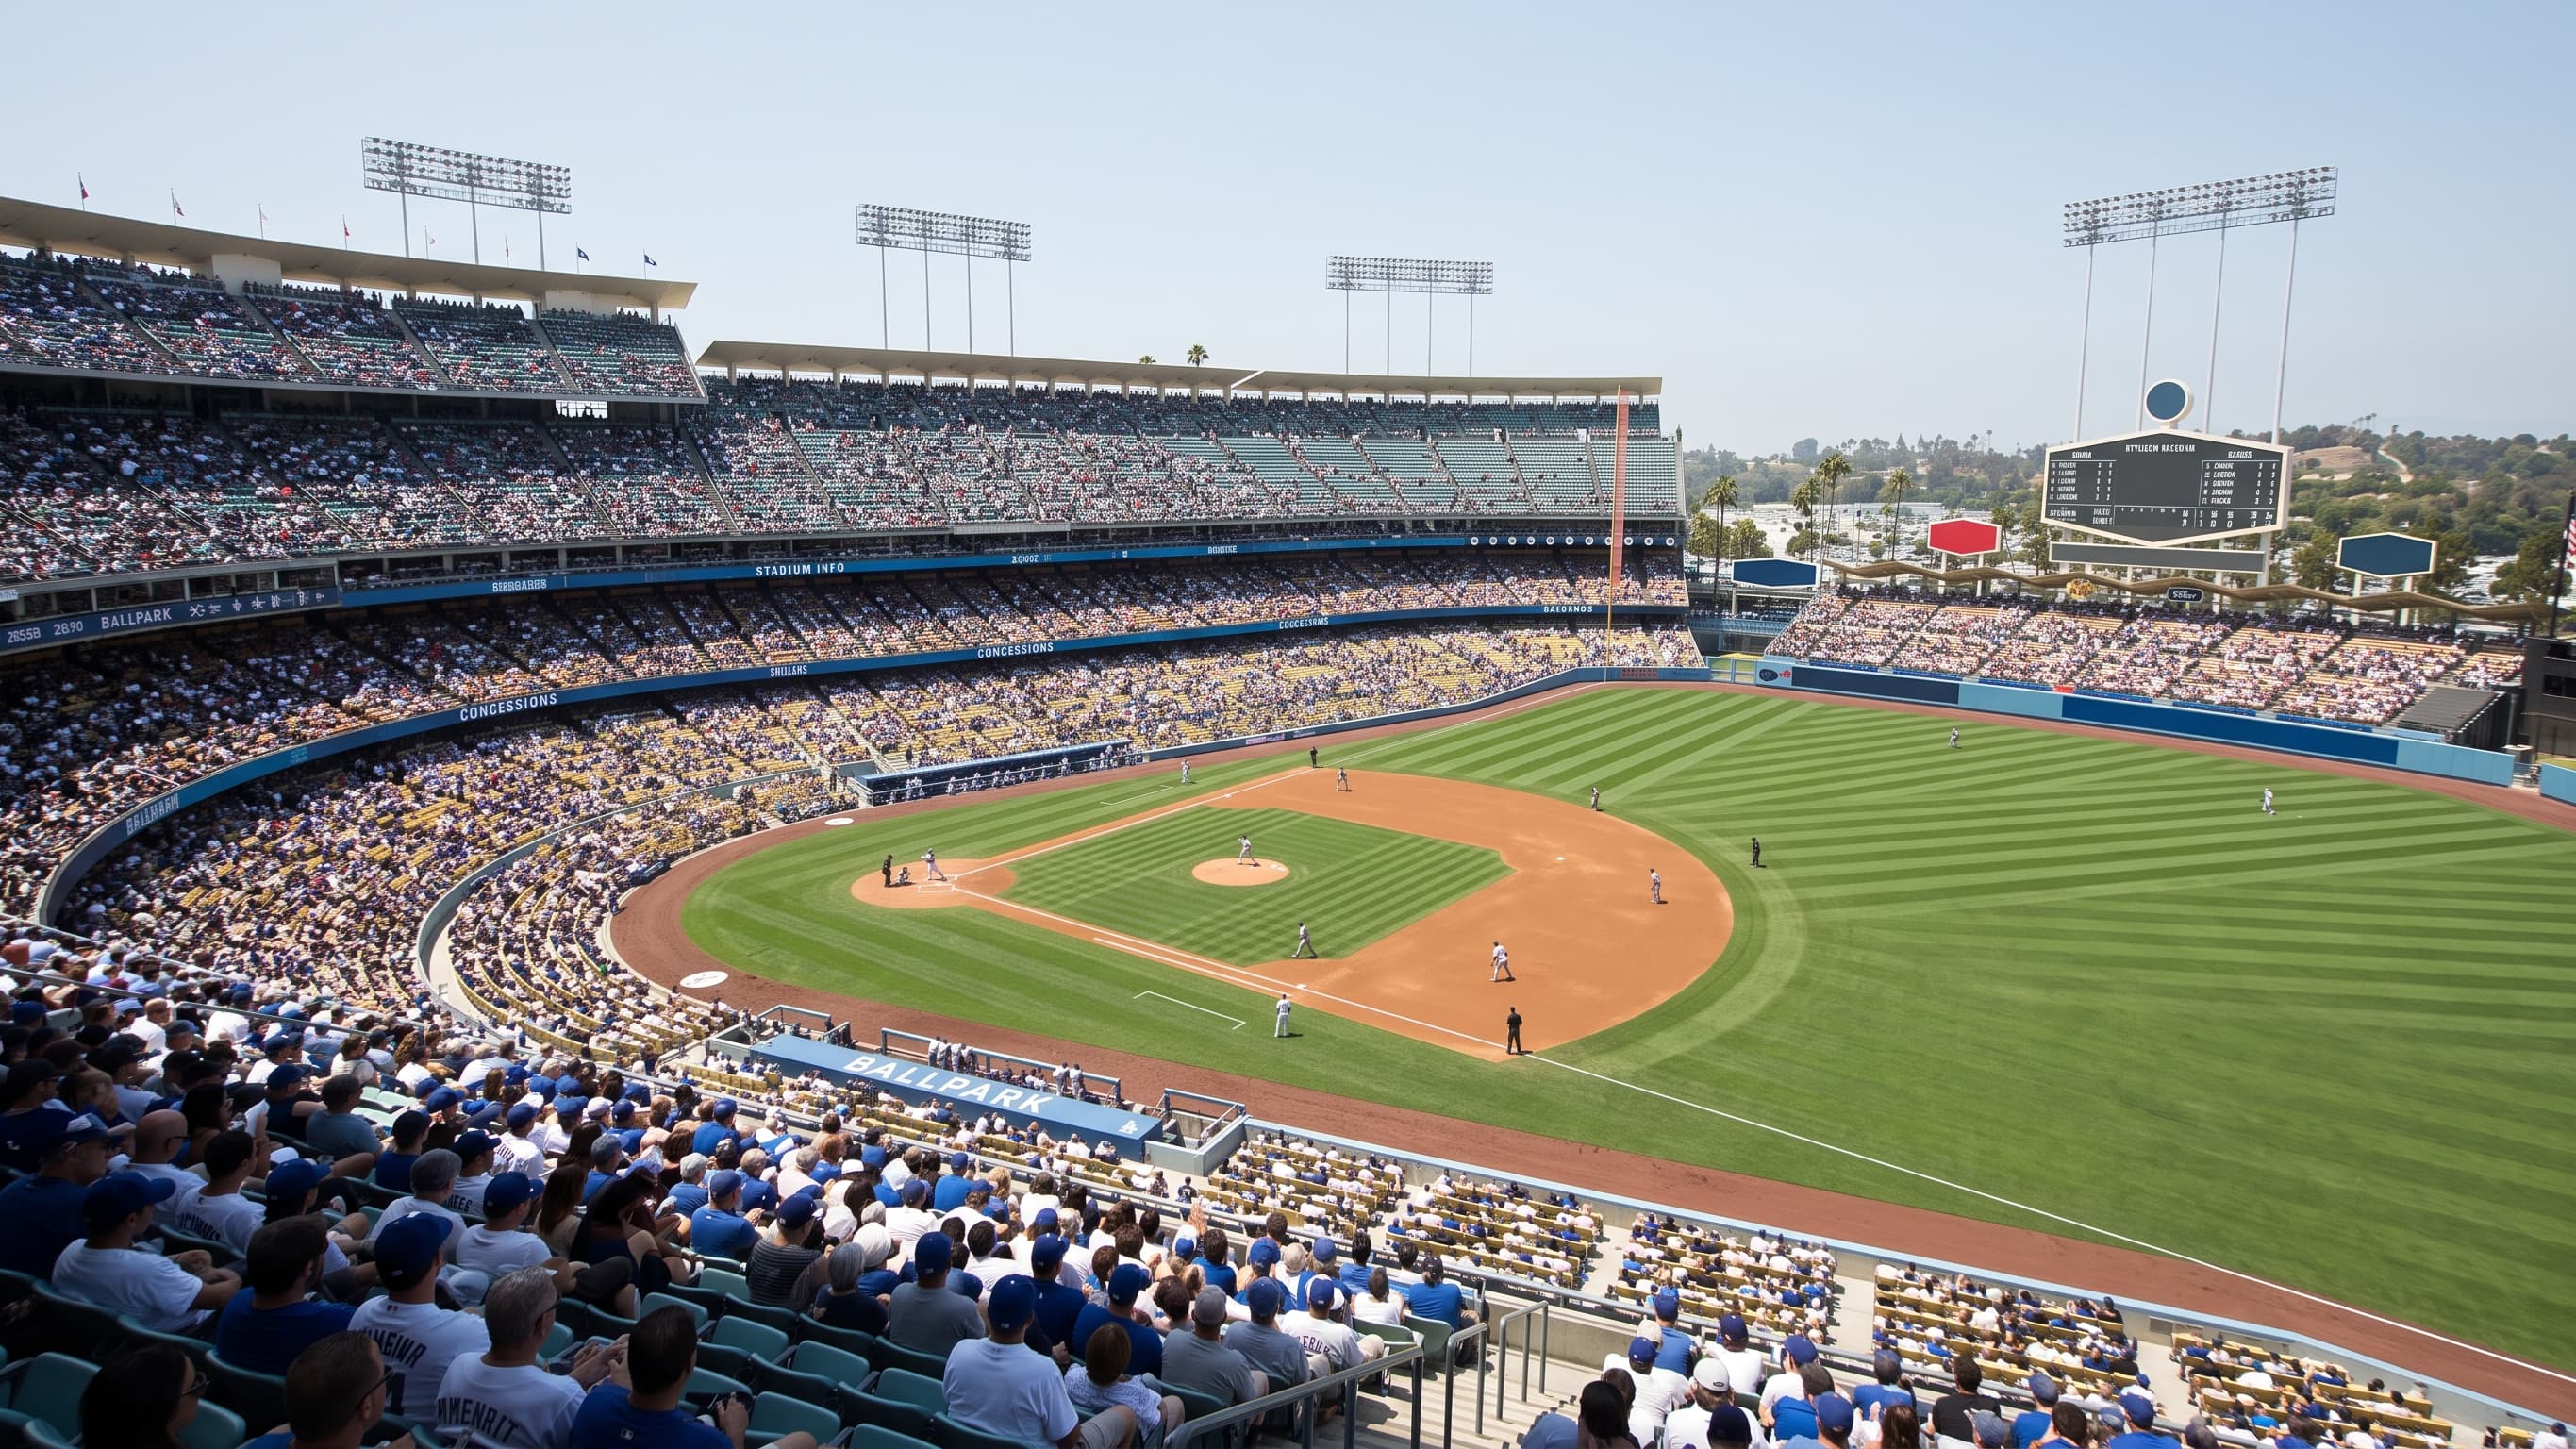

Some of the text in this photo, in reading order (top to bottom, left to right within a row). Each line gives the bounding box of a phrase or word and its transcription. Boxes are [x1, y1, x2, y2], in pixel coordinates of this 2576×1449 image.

[756, 563, 844, 576] STADIUM INFO
[101, 607, 172, 629] BALLPARK
[977, 642, 1054, 658] CONCESSIONS
[460, 693, 557, 722] CONCESSIONS
[843, 1055, 1055, 1114] BALLPARK
